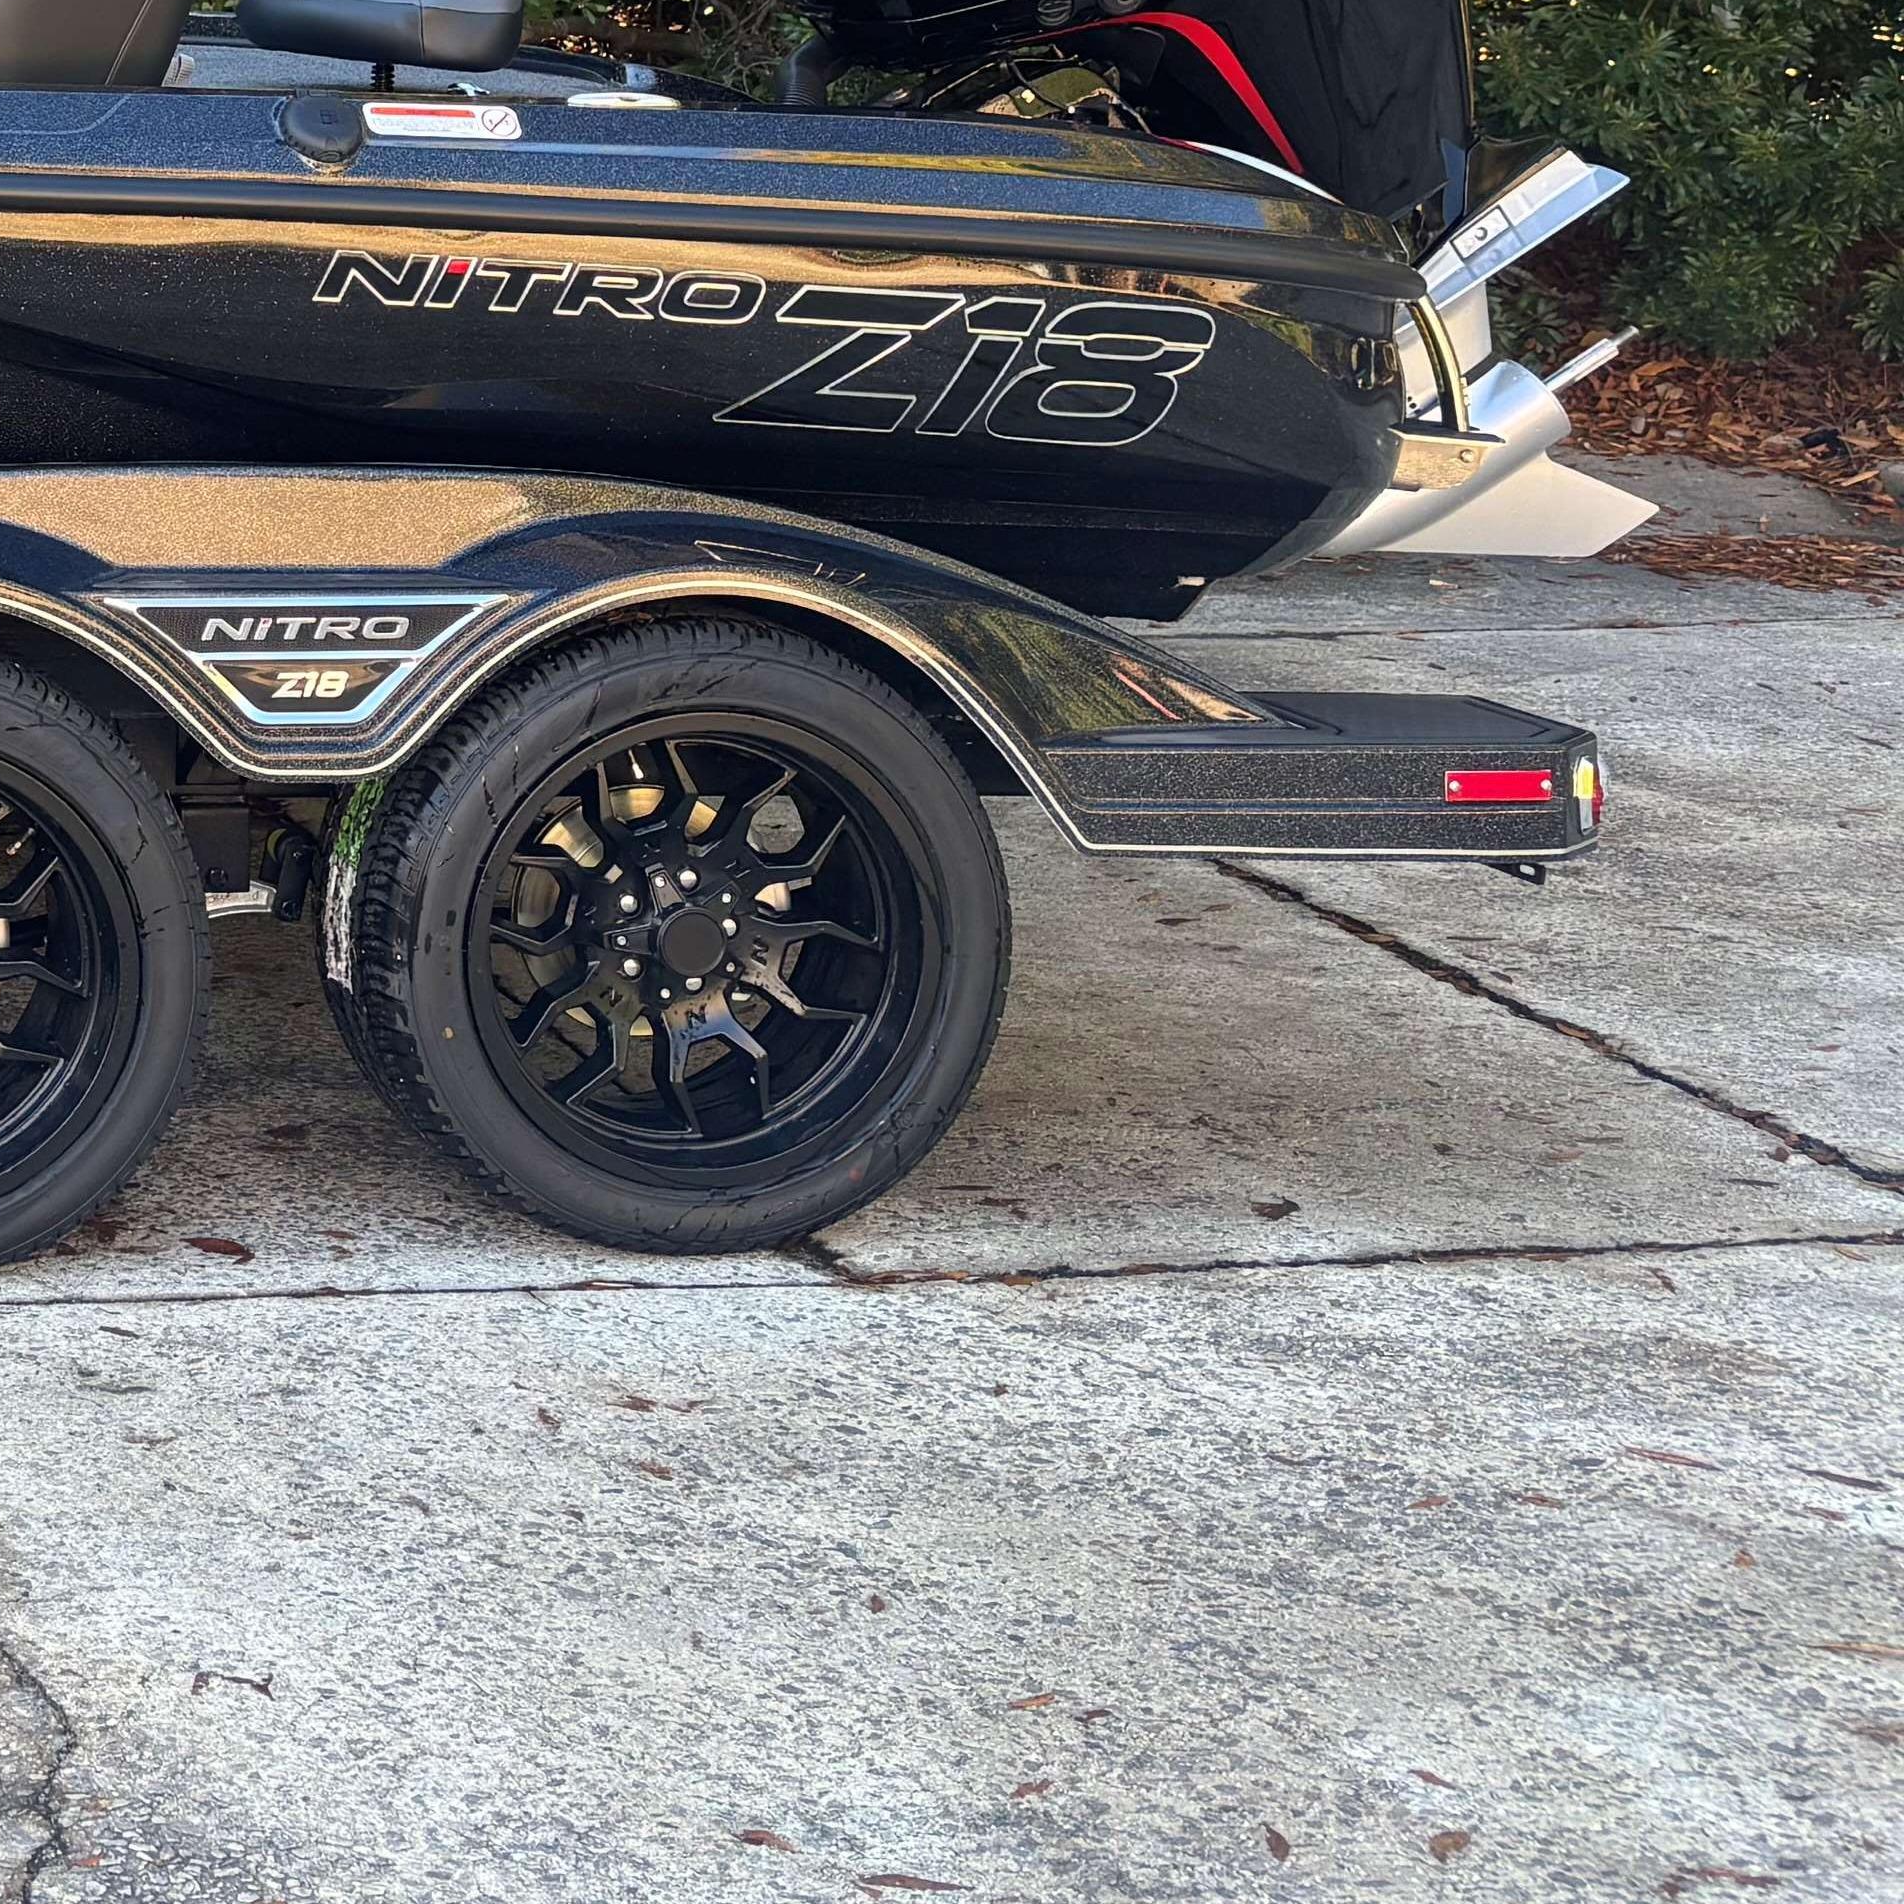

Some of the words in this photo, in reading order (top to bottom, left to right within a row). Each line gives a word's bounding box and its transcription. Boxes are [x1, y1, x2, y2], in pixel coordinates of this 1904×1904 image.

[312, 249, 768, 326] NITRO
[712, 283, 1217, 447] Z18
[200, 615, 410, 642] NITRO
[271, 669, 350, 699] Z18
